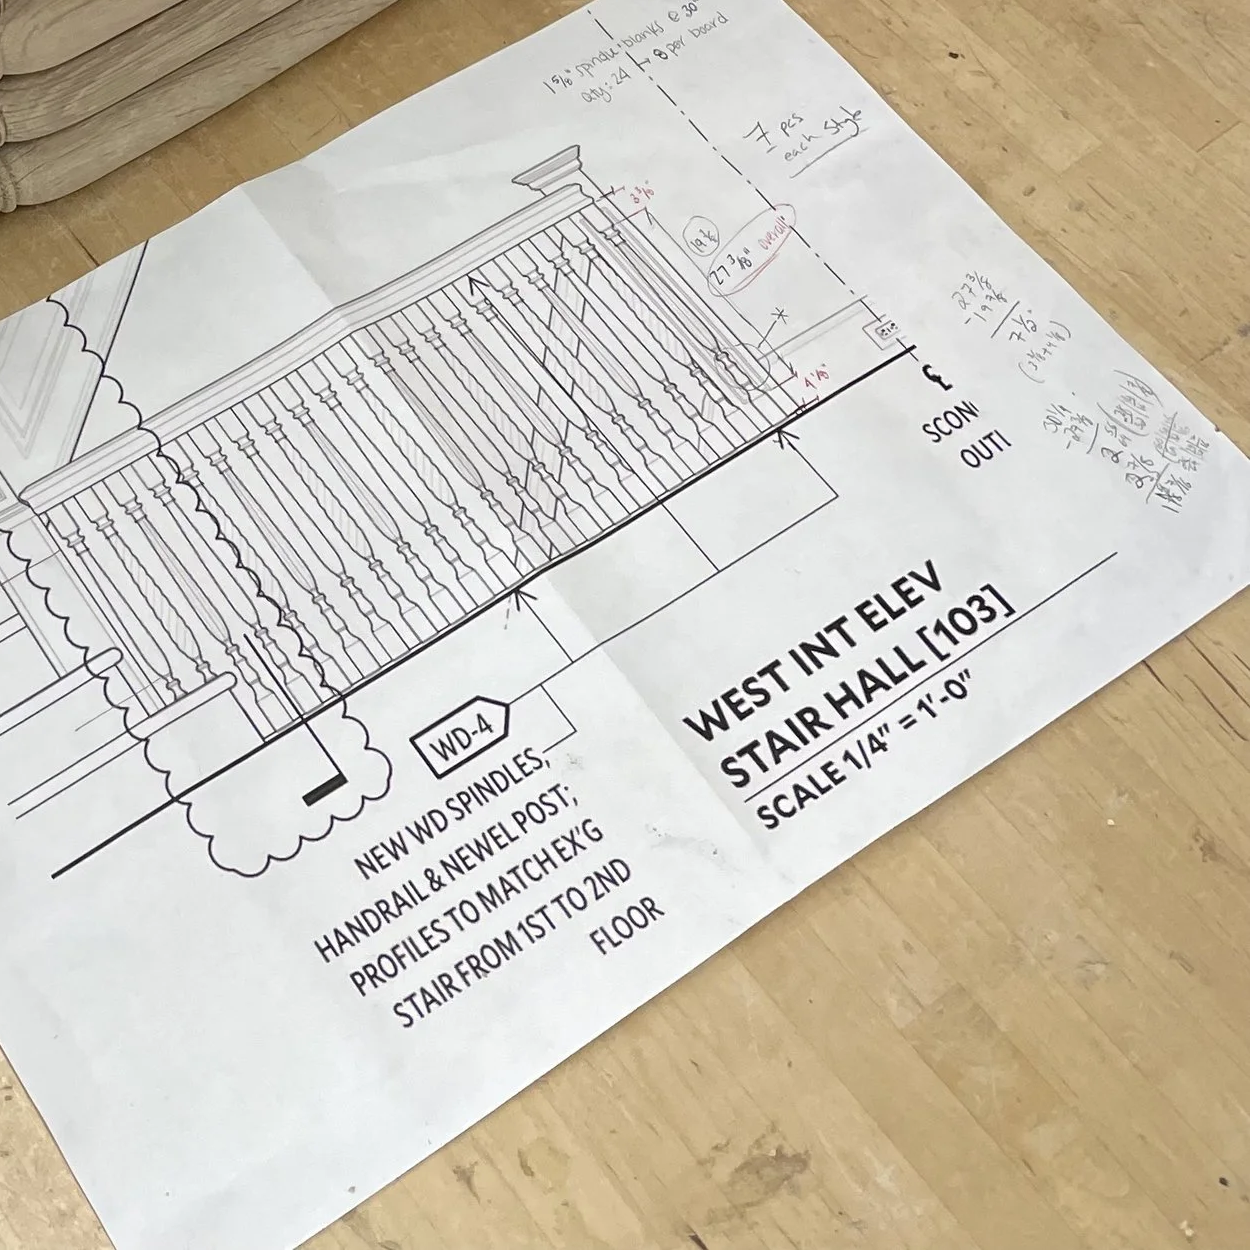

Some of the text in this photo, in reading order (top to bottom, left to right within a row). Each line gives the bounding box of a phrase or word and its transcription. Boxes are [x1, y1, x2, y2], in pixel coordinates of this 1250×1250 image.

[620, 20, 664, 49] blanks
[688, 11, 730, 38] board
[784, 133, 822, 161] each
[922, 400, 980, 443] SCON
[682, 559, 943, 742] WEST INT ELEV
[720, 583, 1016, 789] STAIR HALL [103]
[429, 713, 494, 762] WD-4
[756, 760, 847, 830] SCALE
[842, 723, 891, 769] 1/4"
[353, 747, 551, 880] NEW WD SPINDLES,
[314, 783, 579, 963] HANDRAIL & NEWEL POST;
[349, 818, 603, 997] PROFILES TO MATCH EX'G
[589, 896, 665, 955] FLOOR
[393, 857, 632, 1028] STAIR FROM 1ST TO 2ND
